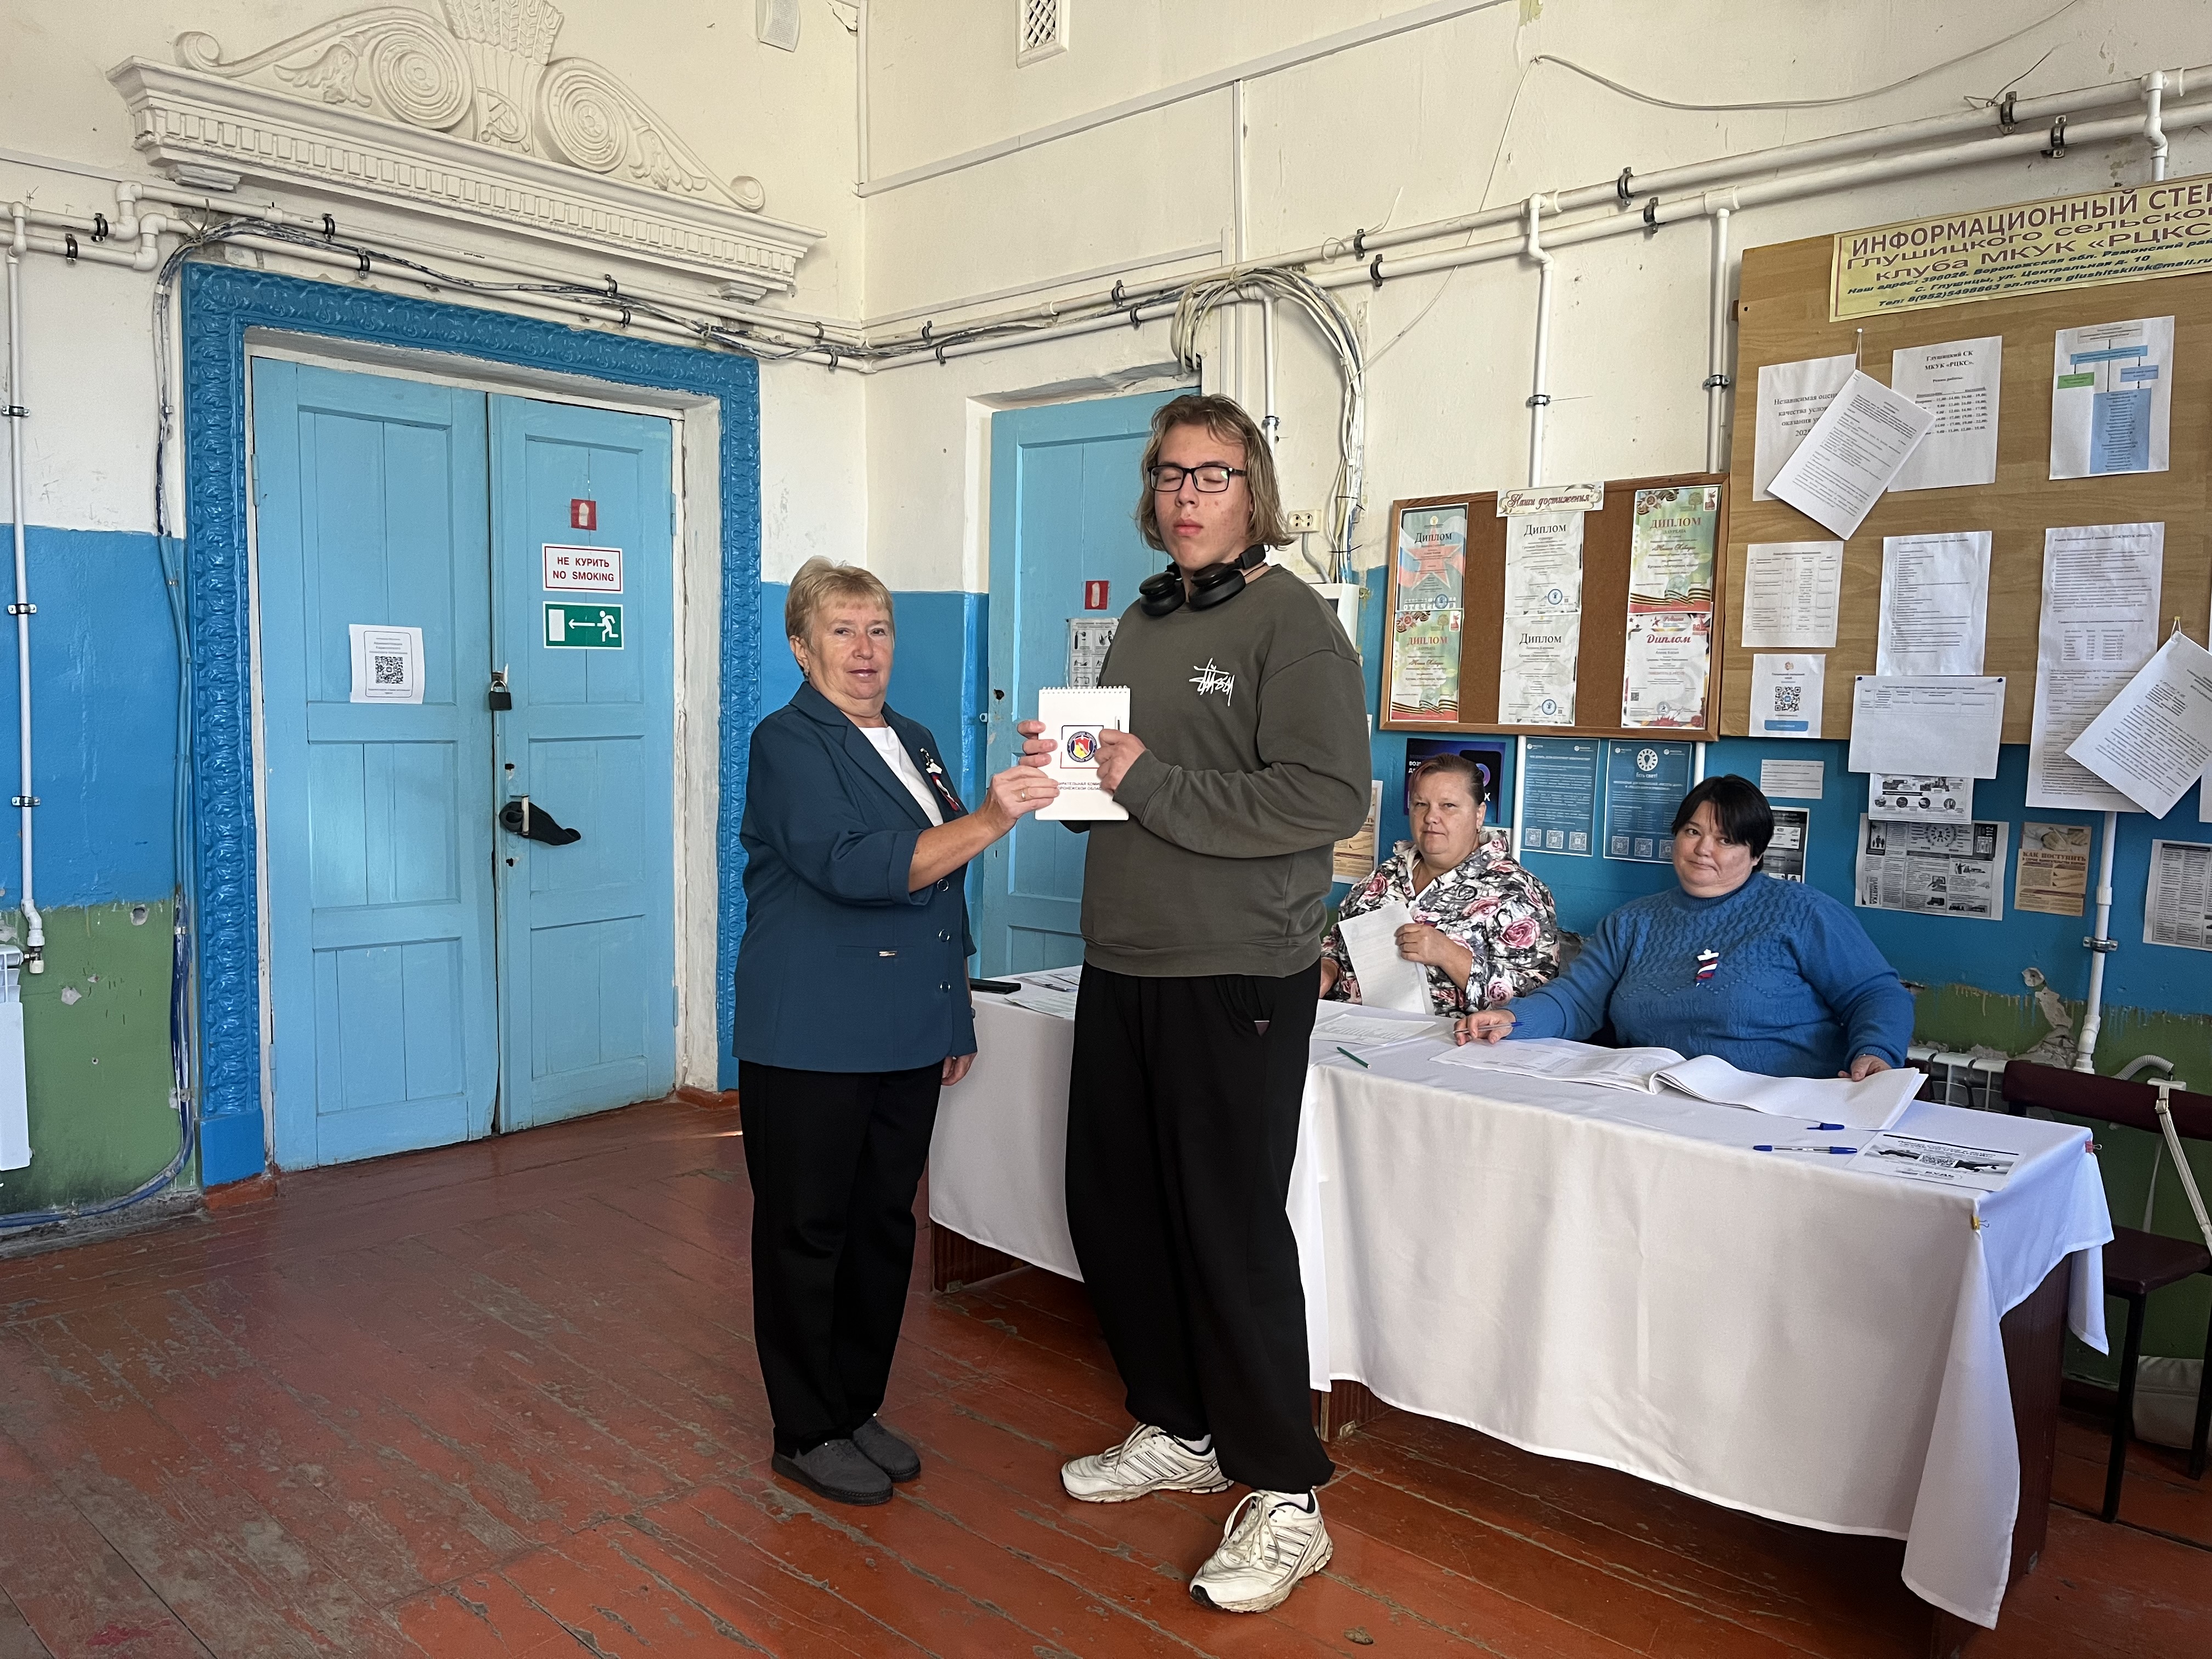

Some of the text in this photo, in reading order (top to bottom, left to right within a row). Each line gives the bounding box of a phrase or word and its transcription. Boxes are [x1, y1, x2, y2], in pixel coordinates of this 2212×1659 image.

[1853, 189, 2137, 257] ИНФОРМАЦИОННЫЙ
[1876, 223, 2211, 281] клуба МКУК «РЦКС
[1973, 258, 2064, 275] Воронежская
[2102, 242, 2183, 257] Рамонский
[2186, 238, 2212, 248] рай
[2021, 261, 2112, 277] Центральная
[2134, 255, 2151, 263] 10
[1878, 298, 1905, 307] Тел:
[1925, 363, 1945, 371] МКУК
[1774, 395, 1817, 405] Независимая
[1781, 418, 1811, 426] оказания
[1507, 493, 1590, 510] Наши достижения
[1649, 517, 1702, 529] ДИПЛОМ
[1523, 524, 1566, 537] Диплом
[1414, 532, 1452, 544] Диплом
[557, 556, 610, 568] НЕ КУРИТЬ
[552, 570, 614, 582] NO SMOKING
[1407, 636, 1448, 646] ДИПЛОМ
[1519, 633, 1562, 645] Диплом
[1646, 634, 1691, 644] Диплом
[2041, 853, 2086, 862] ПОСТУПИТЬ
